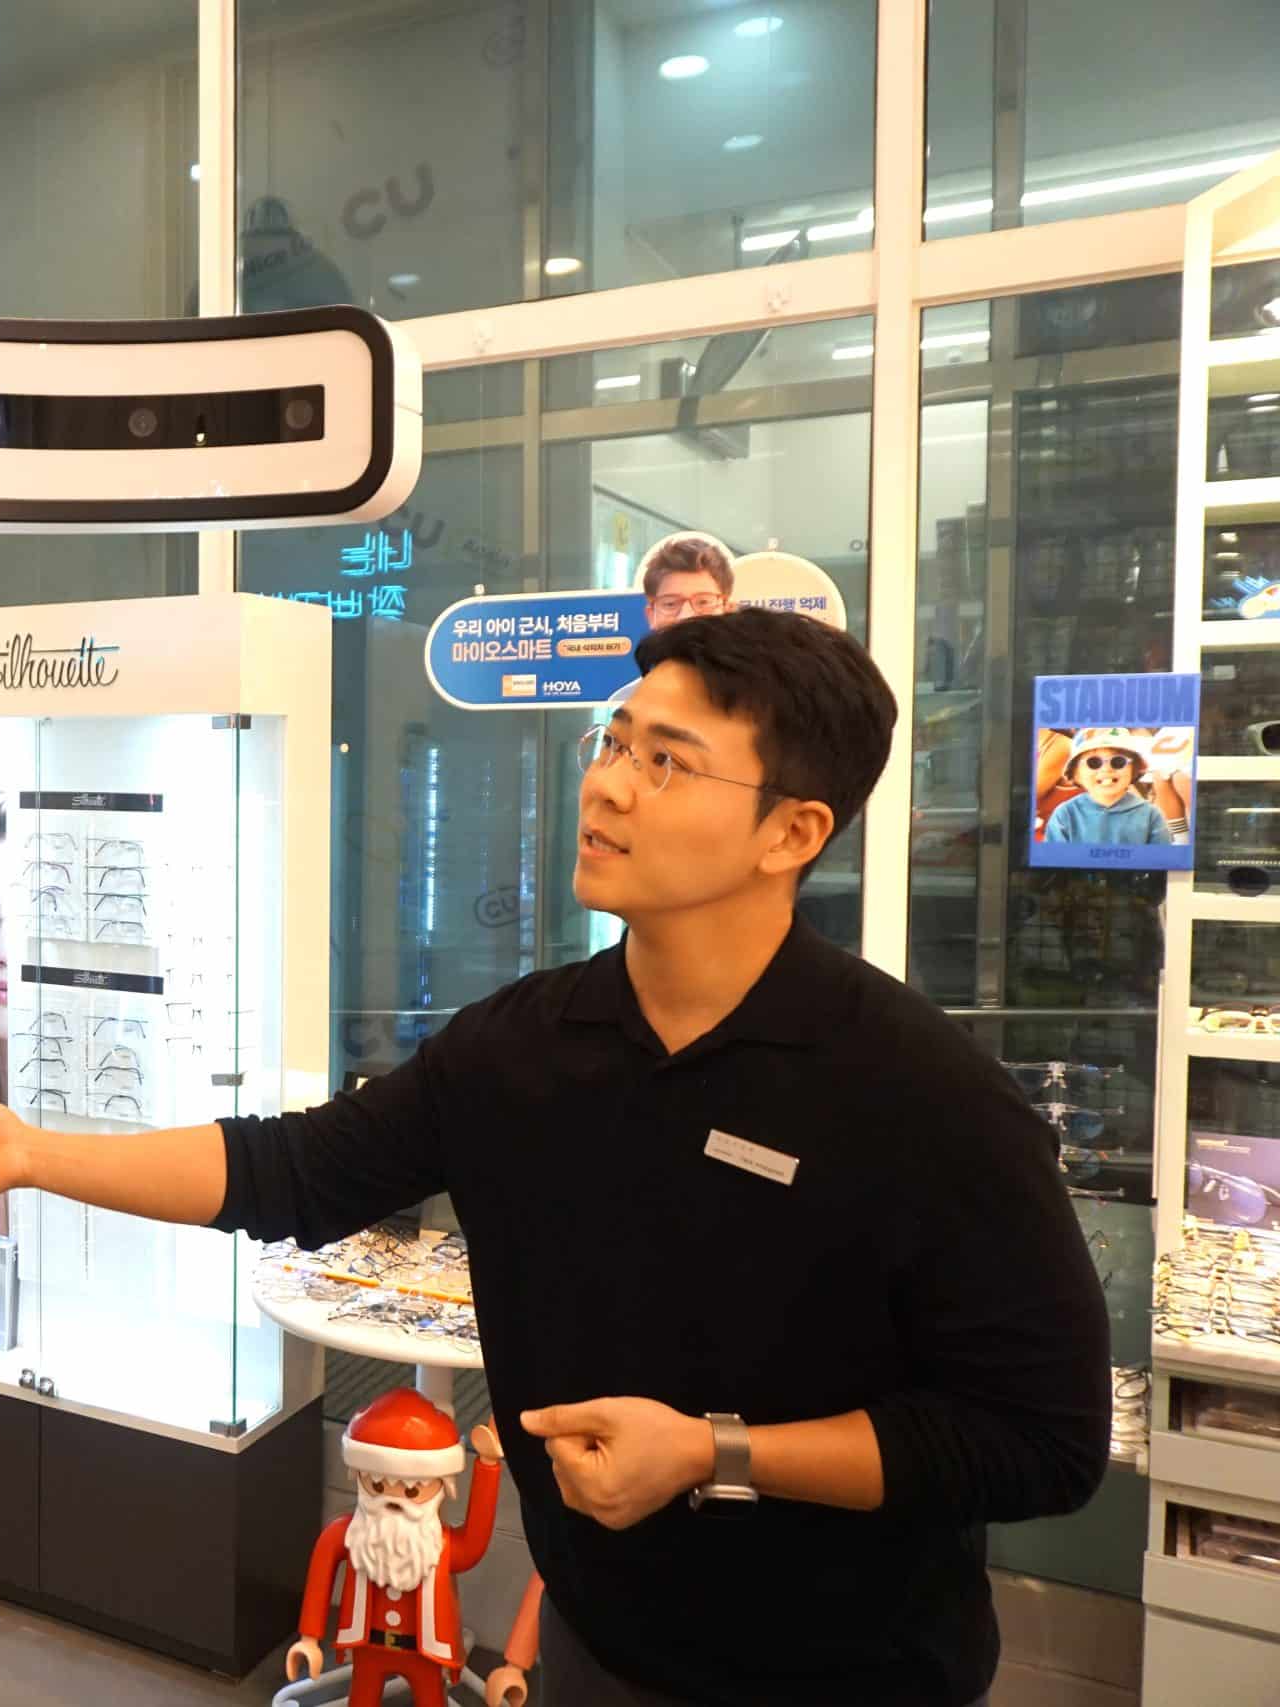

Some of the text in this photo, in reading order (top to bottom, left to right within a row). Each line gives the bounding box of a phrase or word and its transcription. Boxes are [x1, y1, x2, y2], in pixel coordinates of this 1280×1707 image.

[799, 596, 827, 612] 억제
[453, 612, 619, 638] 우리 아이 근시, 처음부터
[452, 638, 553, 662] 마이오스마트
[542, 680, 582, 693] HOYA
[1038, 675, 1196, 725] STADIUM
